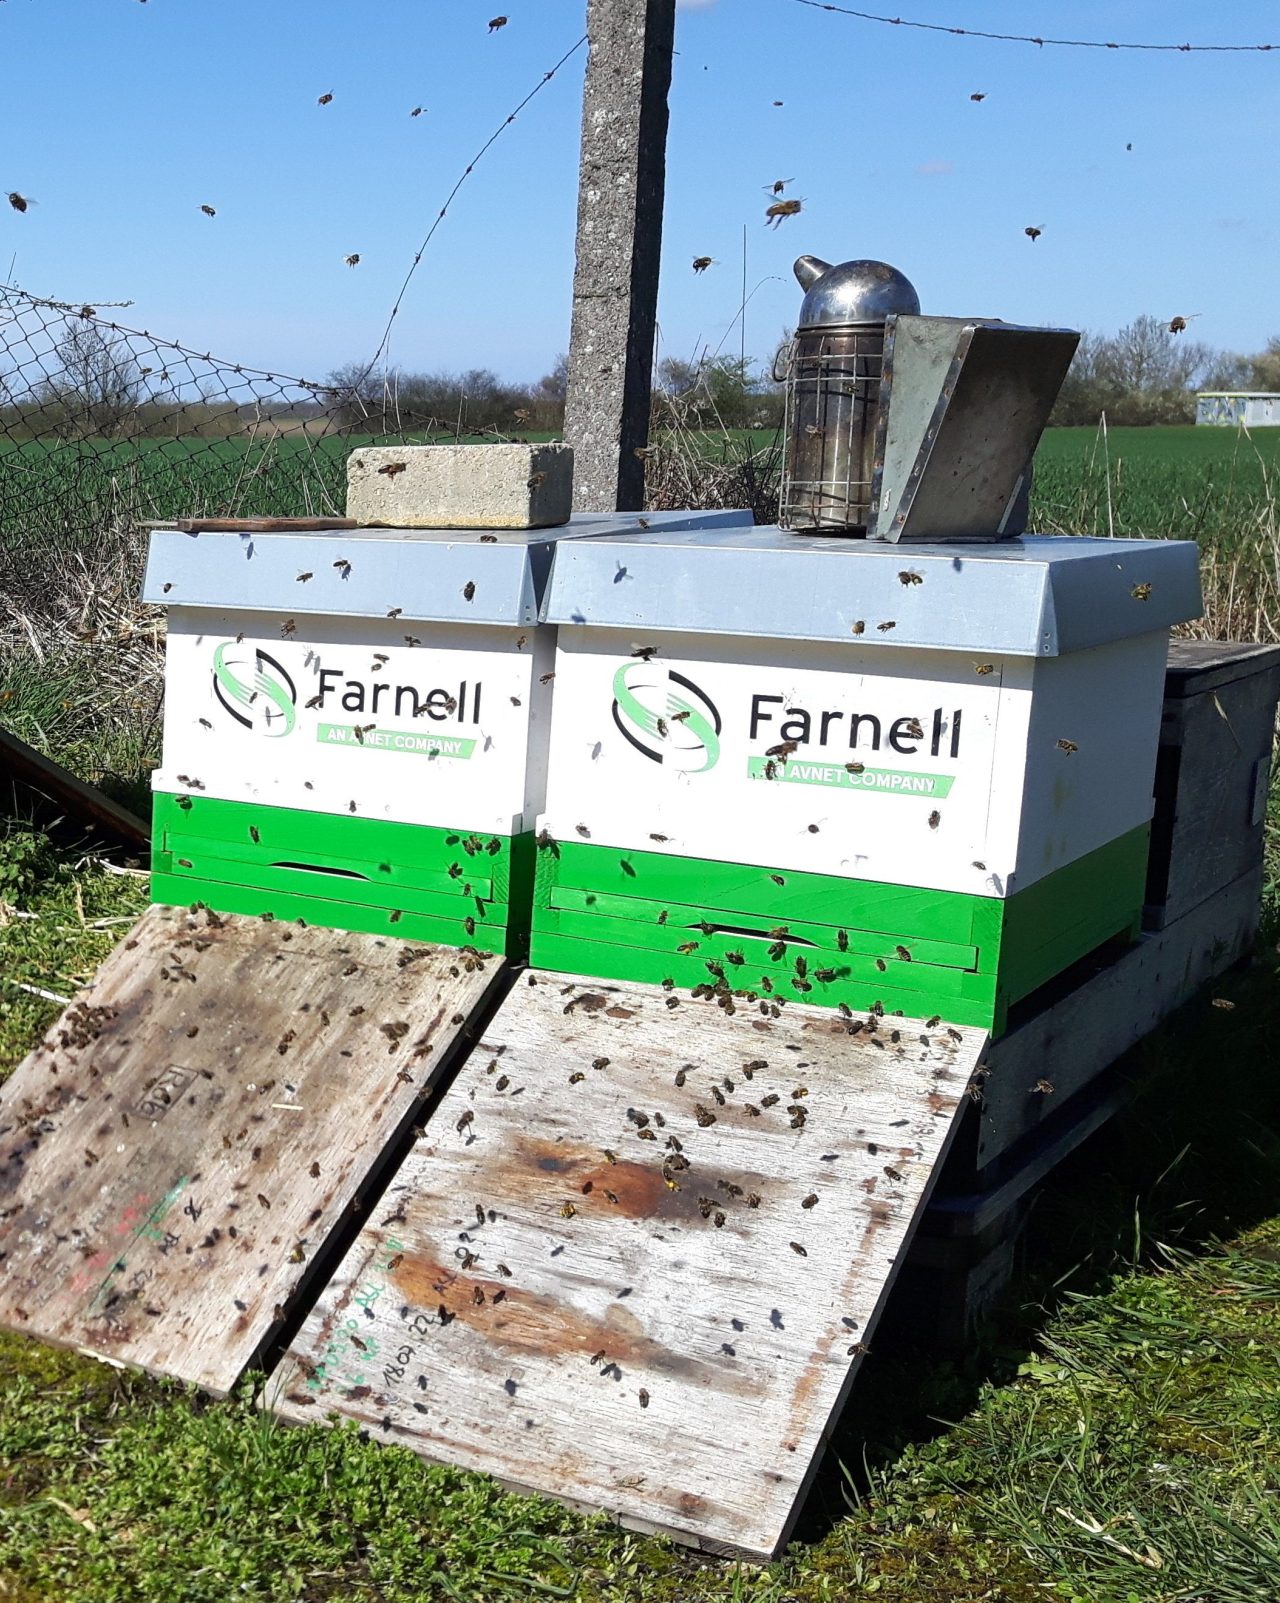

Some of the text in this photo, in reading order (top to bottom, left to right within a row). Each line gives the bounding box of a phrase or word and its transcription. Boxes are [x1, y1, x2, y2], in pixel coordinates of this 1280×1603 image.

[319, 669, 482, 724] Farnell
[327, 727, 463, 754] AN ANET COMPANY
[749, 694, 962, 758] Farnell
[790, 764, 845, 783] AVNET
[848, 770, 936, 793] COMPANY
